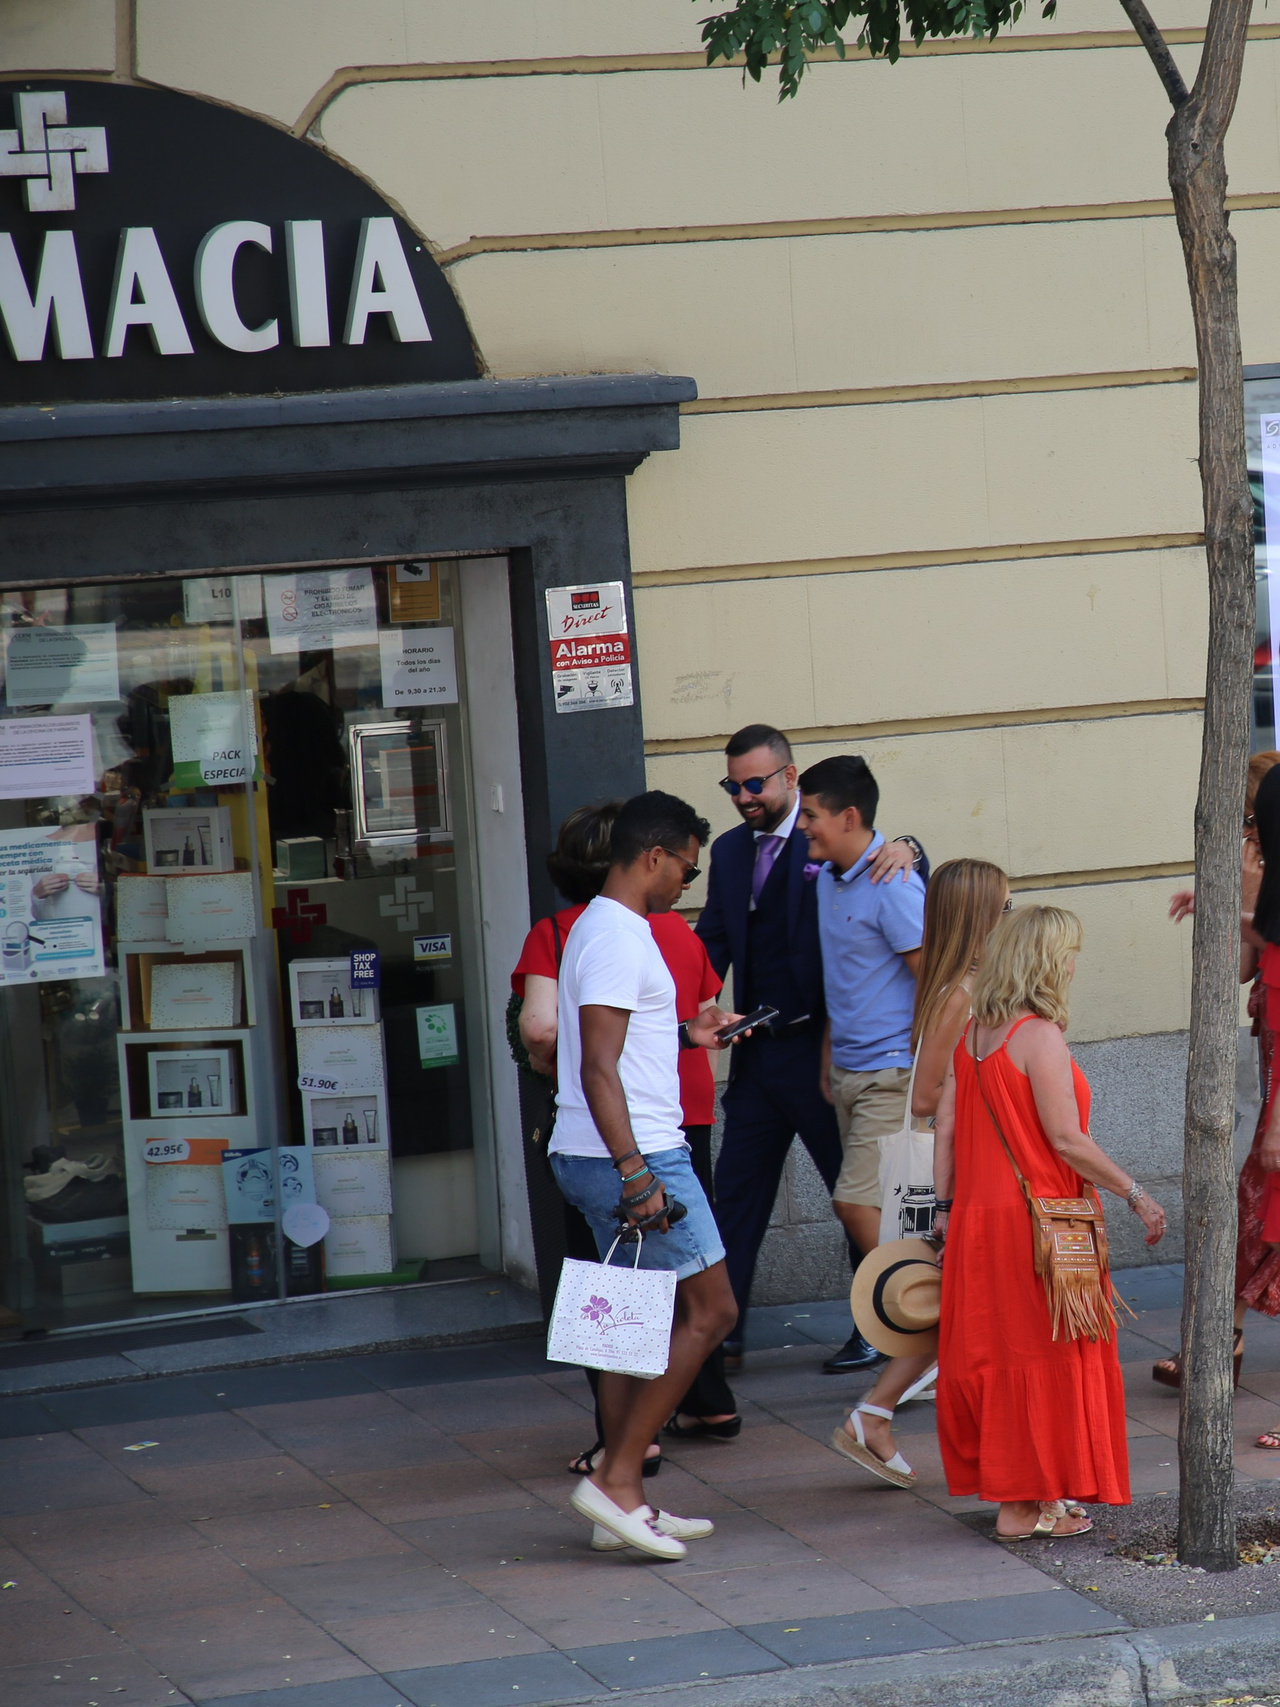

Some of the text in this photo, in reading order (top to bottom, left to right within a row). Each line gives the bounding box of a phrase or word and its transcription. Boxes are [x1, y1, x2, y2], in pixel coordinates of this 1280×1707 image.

[211, 588, 232, 599] L10
[304, 584, 365, 596] PROHIBIDO FUMAR
[572, 602, 600, 610] SECURITAS
[561, 605, 614, 633] Direct
[556, 641, 624, 658] Alarma
[571, 658, 593, 666] Aviso
[600, 654, 625, 663] Policía
[407, 687, 421, 695] 9,30
[428, 686, 446, 694] 21,30
[212, 750, 241, 760] PACK
[203, 767, 246, 780] ESPECIA
[419, 941, 447, 952] VISA
[353, 953, 376, 962] SHOP
[353, 962, 371, 970] TAX
[353, 970, 375, 978] FREE
[301, 1076, 338, 1091] 51.90€
[147, 1143, 183, 1157] 42.95€
